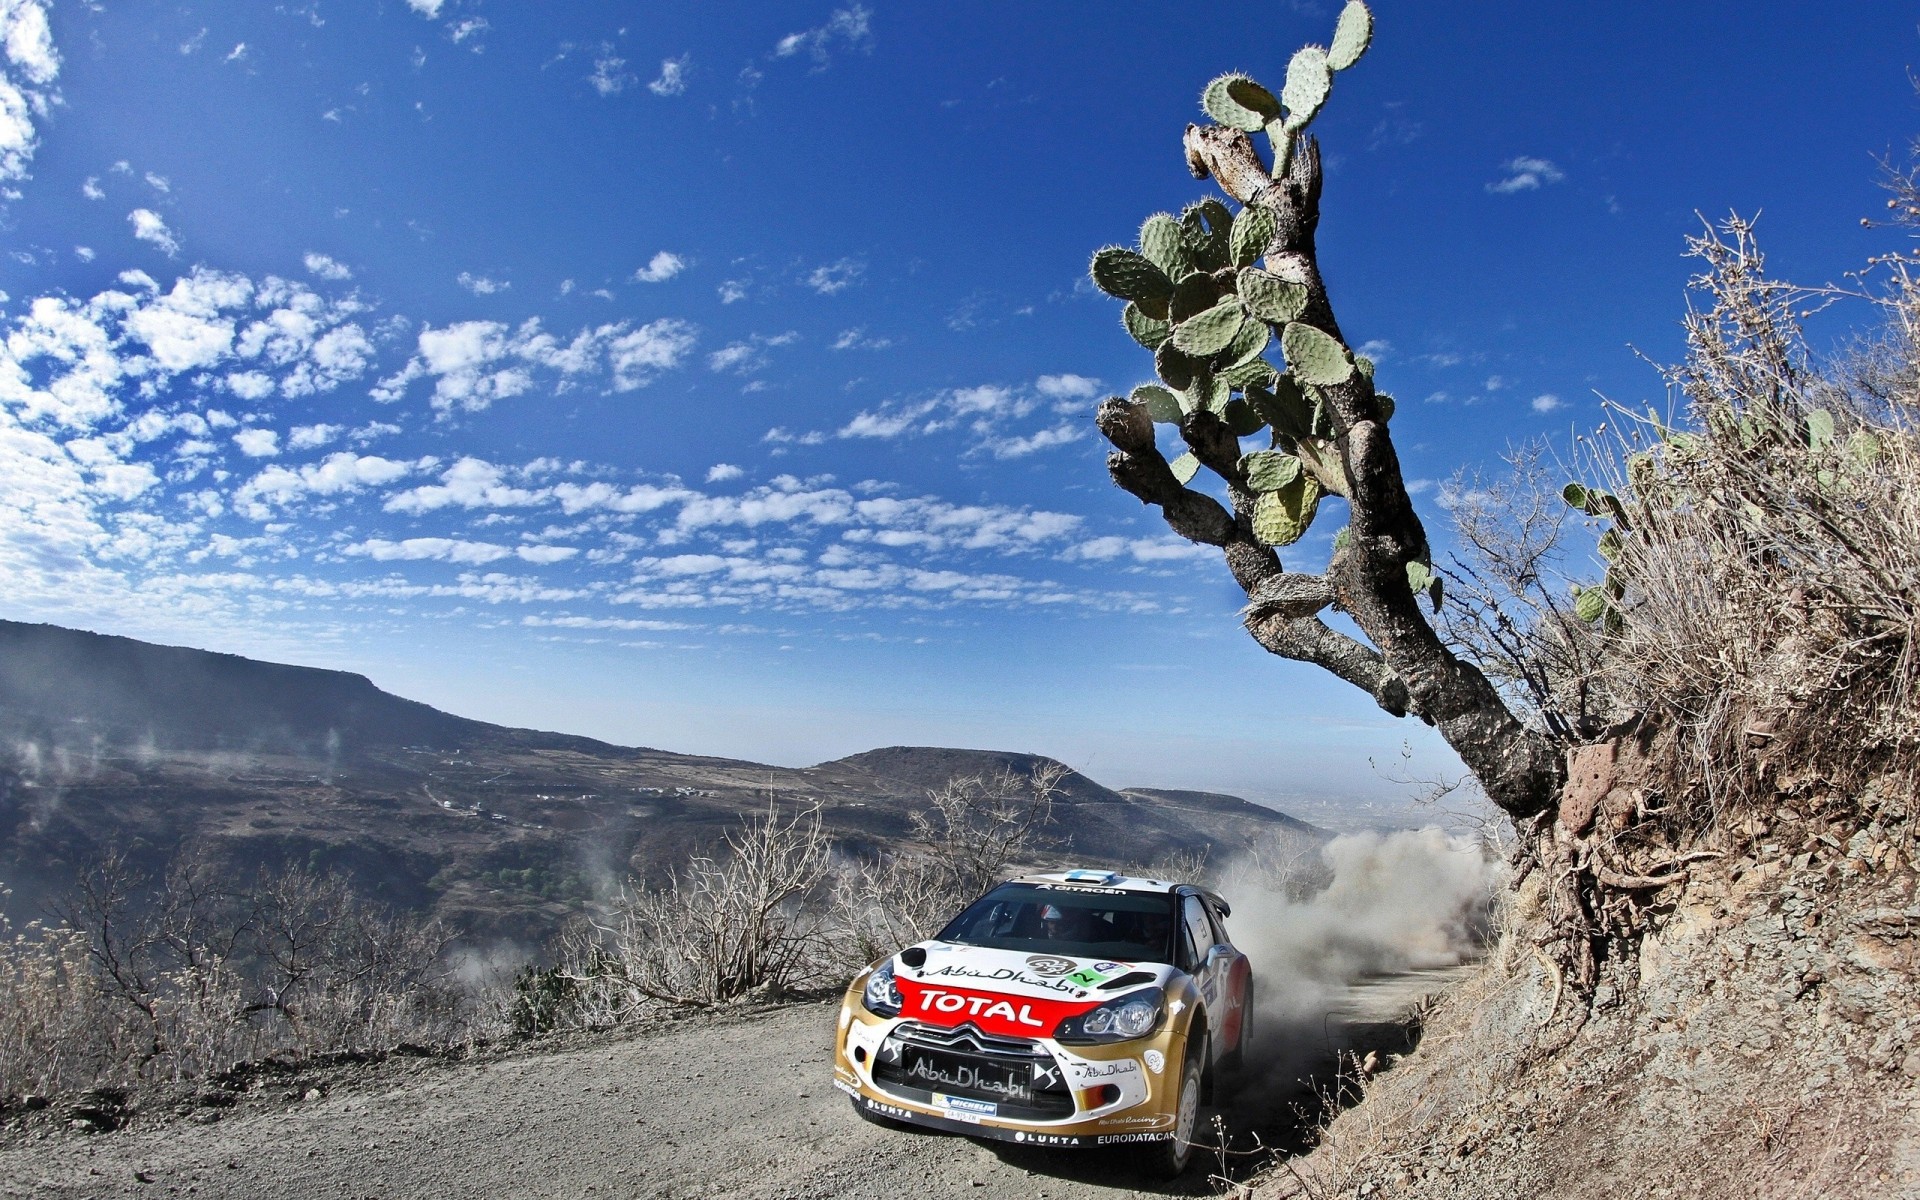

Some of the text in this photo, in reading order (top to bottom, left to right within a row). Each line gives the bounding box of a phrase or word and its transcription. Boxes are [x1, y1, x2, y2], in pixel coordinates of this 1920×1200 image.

[1073, 973, 1095, 983] 2
[919, 989, 1044, 1027] TOTAL
[874, 1102, 912, 1118] LUHTA
[950, 1099, 995, 1112] MICHELIN
[1125, 1116, 1163, 1126] Racing
[1027, 1133, 1079, 1145] LUHTA
[1097, 1131, 1175, 1145] EURODATACAR
